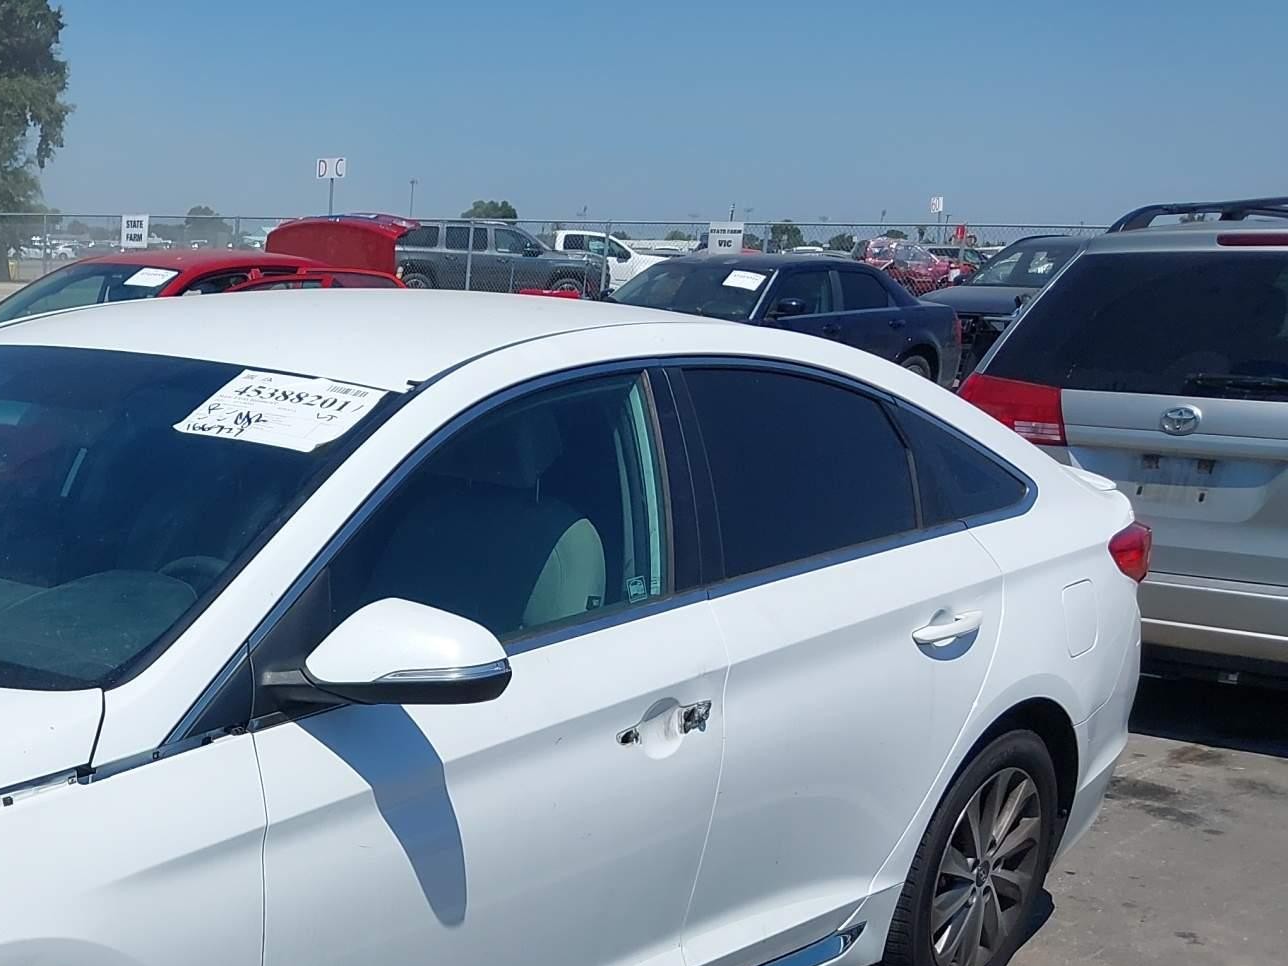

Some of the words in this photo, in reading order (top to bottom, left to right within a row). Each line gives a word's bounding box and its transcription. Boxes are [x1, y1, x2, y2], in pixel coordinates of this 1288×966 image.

[318, 159, 327, 178] D
[335, 158, 344, 177] C
[126, 220, 144, 229] STATE
[126, 233, 143, 242] FARM
[718, 239, 732, 248] VIC
[234, 384, 352, 412] 45388201
